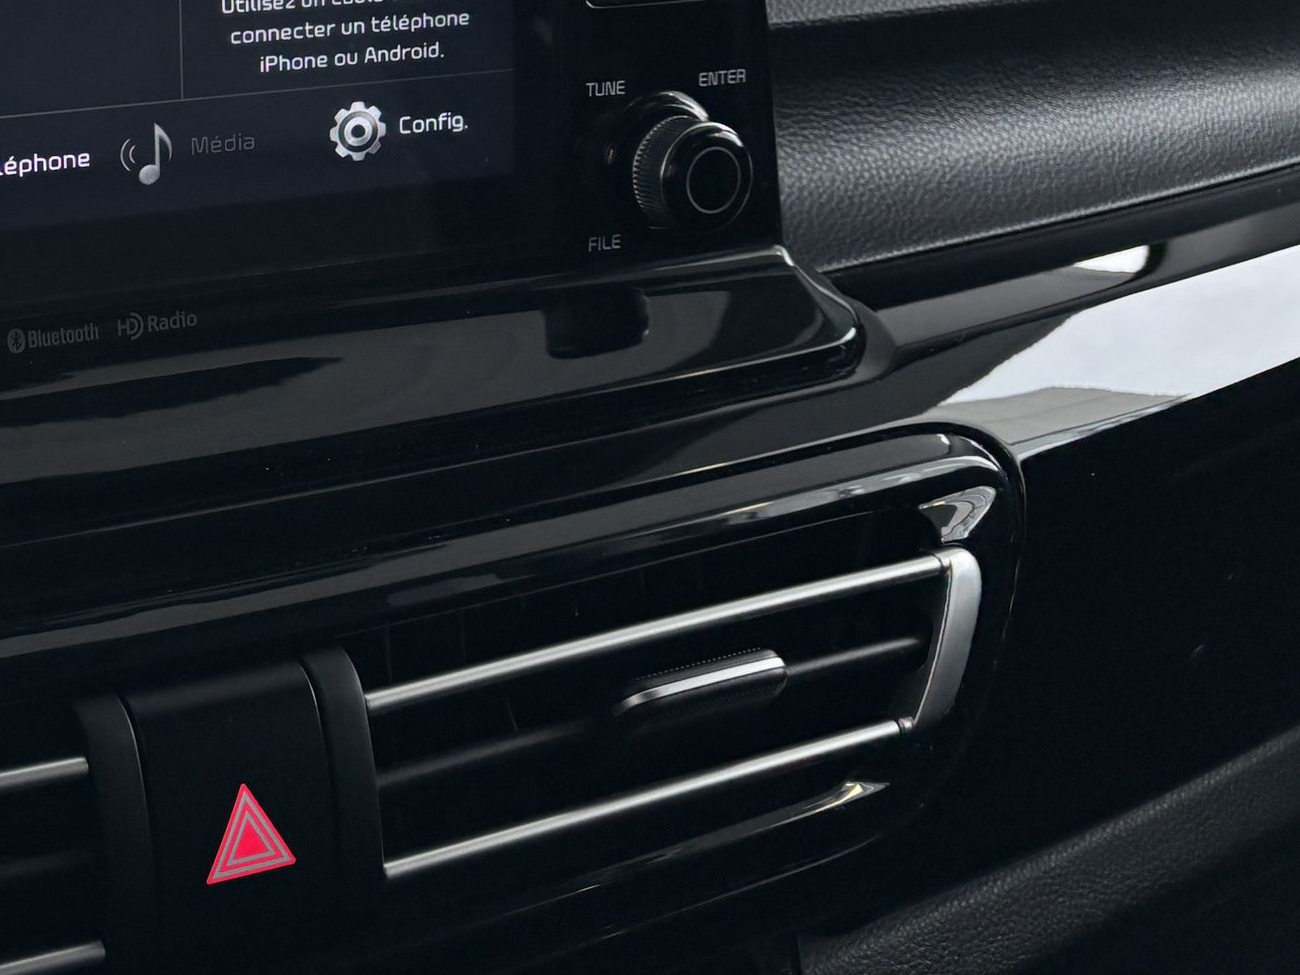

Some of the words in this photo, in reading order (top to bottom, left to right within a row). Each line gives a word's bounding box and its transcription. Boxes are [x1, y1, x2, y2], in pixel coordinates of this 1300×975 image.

[230, 21, 336, 45] connecter
[341, 21, 366, 36] un
[370, 12, 470, 33] téléphone
[260, 54, 328, 73] iPhone
[334, 52, 358, 67] ou
[364, 41, 445, 64] Android.
[585, 79, 626, 98] TUNE
[698, 68, 747, 87] ENTER
[399, 111, 469, 135] Config.
[191, 132, 255, 156] Média
[588, 233, 621, 253] FILE
[147, 310, 198, 333] Radio
[27, 322, 100, 349] Bluetooth
